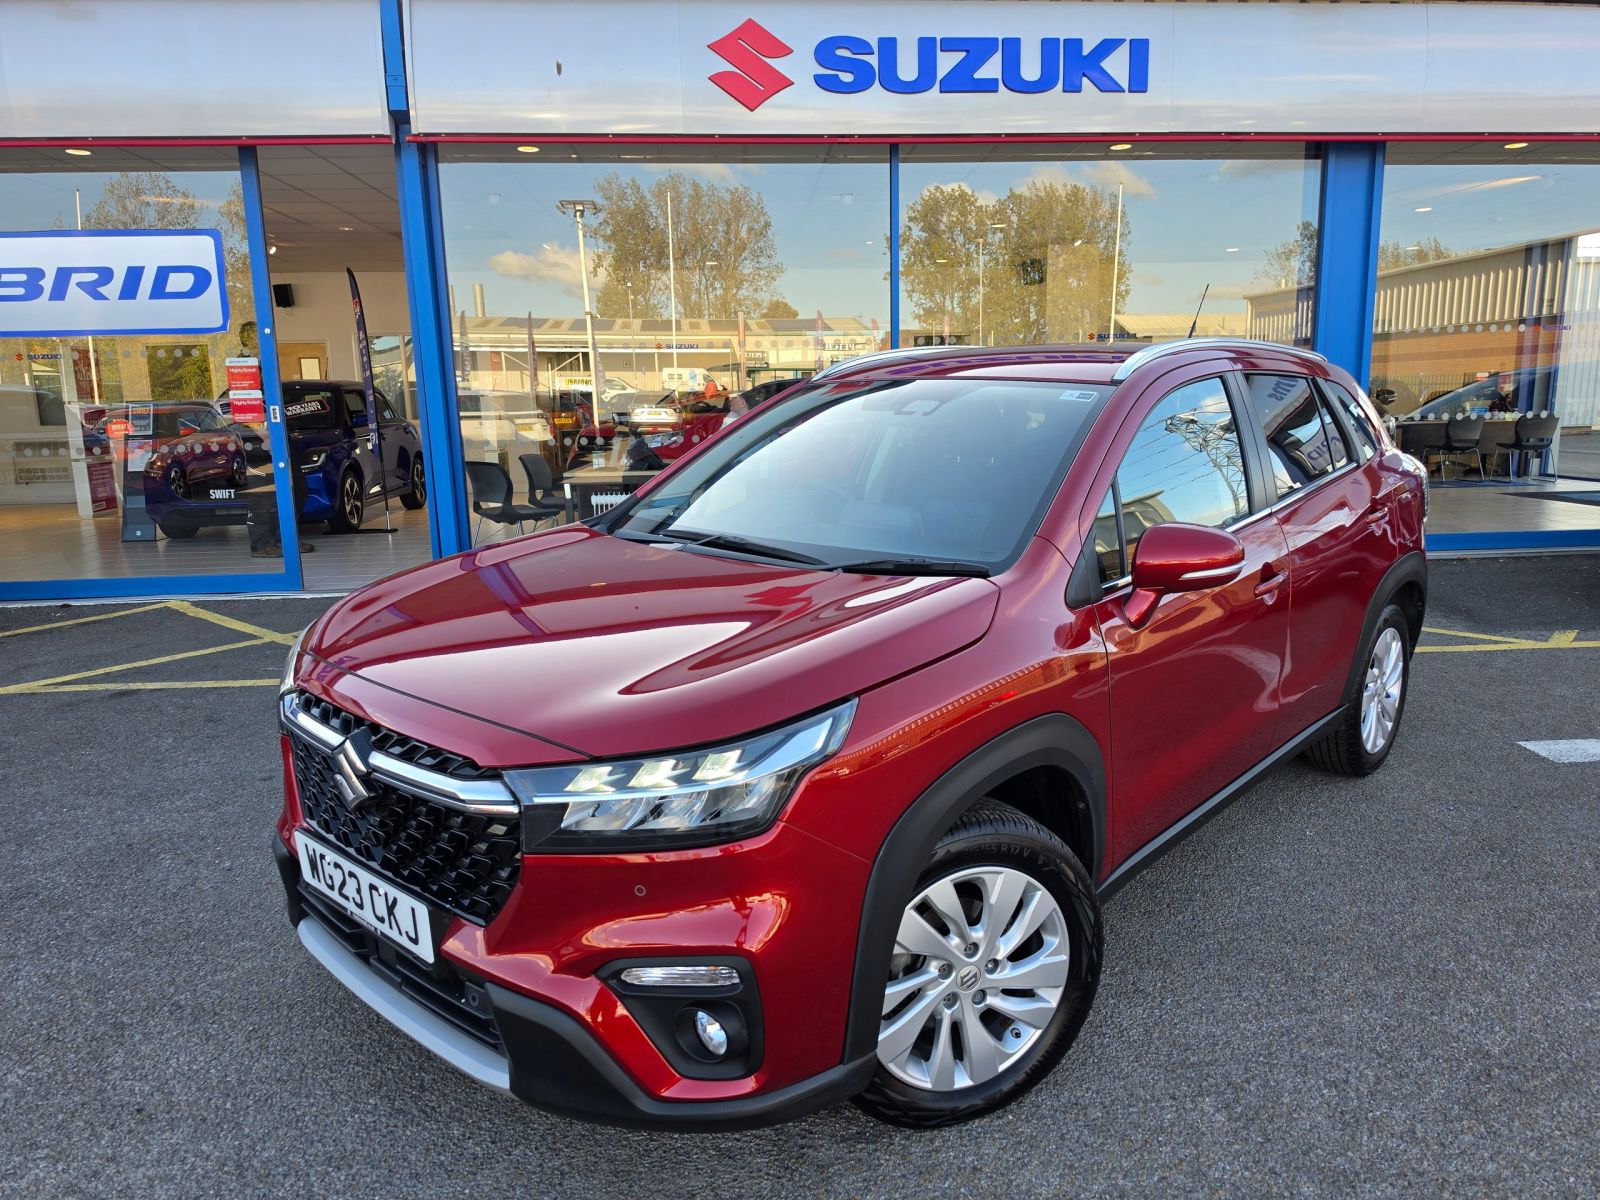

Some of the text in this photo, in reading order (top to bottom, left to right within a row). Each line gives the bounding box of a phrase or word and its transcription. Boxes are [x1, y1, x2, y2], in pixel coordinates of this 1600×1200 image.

[813, 35, 1150, 94] SUZUKI
[0, 265, 212, 302] BRID
[26, 353, 63, 361] SUZUKI
[285, 405, 322, 416] WARRANTY
[209, 489, 235, 499] SWIFT
[304, 843, 365, 911] WG23
[368, 882, 420, 946] CKJ
